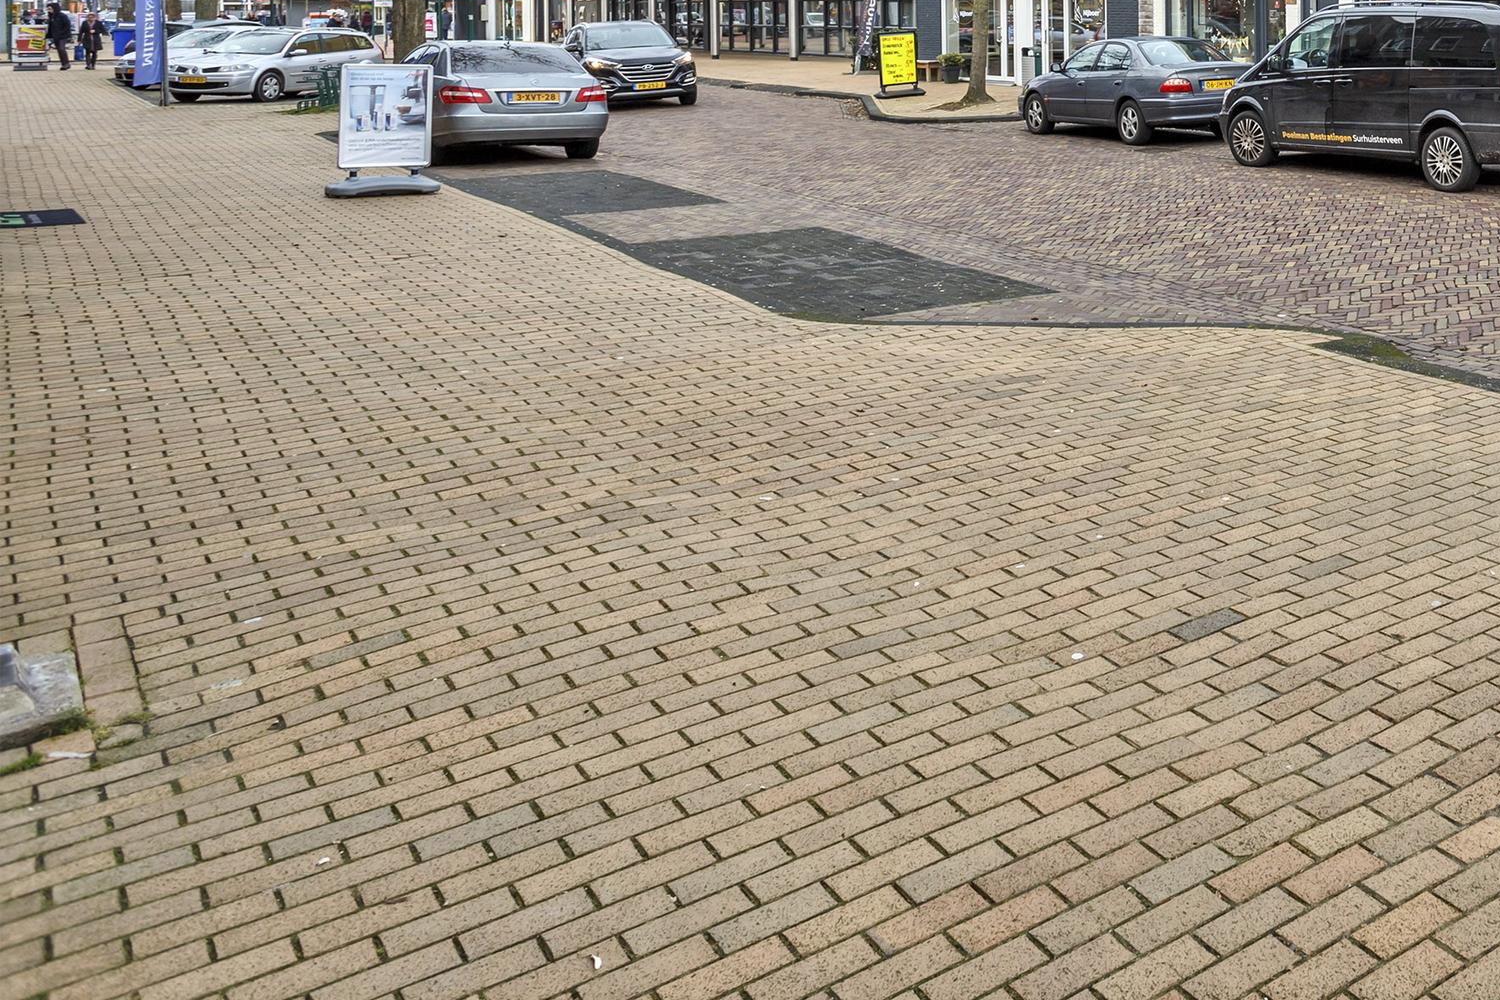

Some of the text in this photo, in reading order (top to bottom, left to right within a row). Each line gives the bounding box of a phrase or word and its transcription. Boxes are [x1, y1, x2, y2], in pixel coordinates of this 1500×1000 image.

[516, 93, 556, 101] 3-XVT-28
[1282, 131, 1403, 145] Poelman Bestratingen Surhuisterveen
